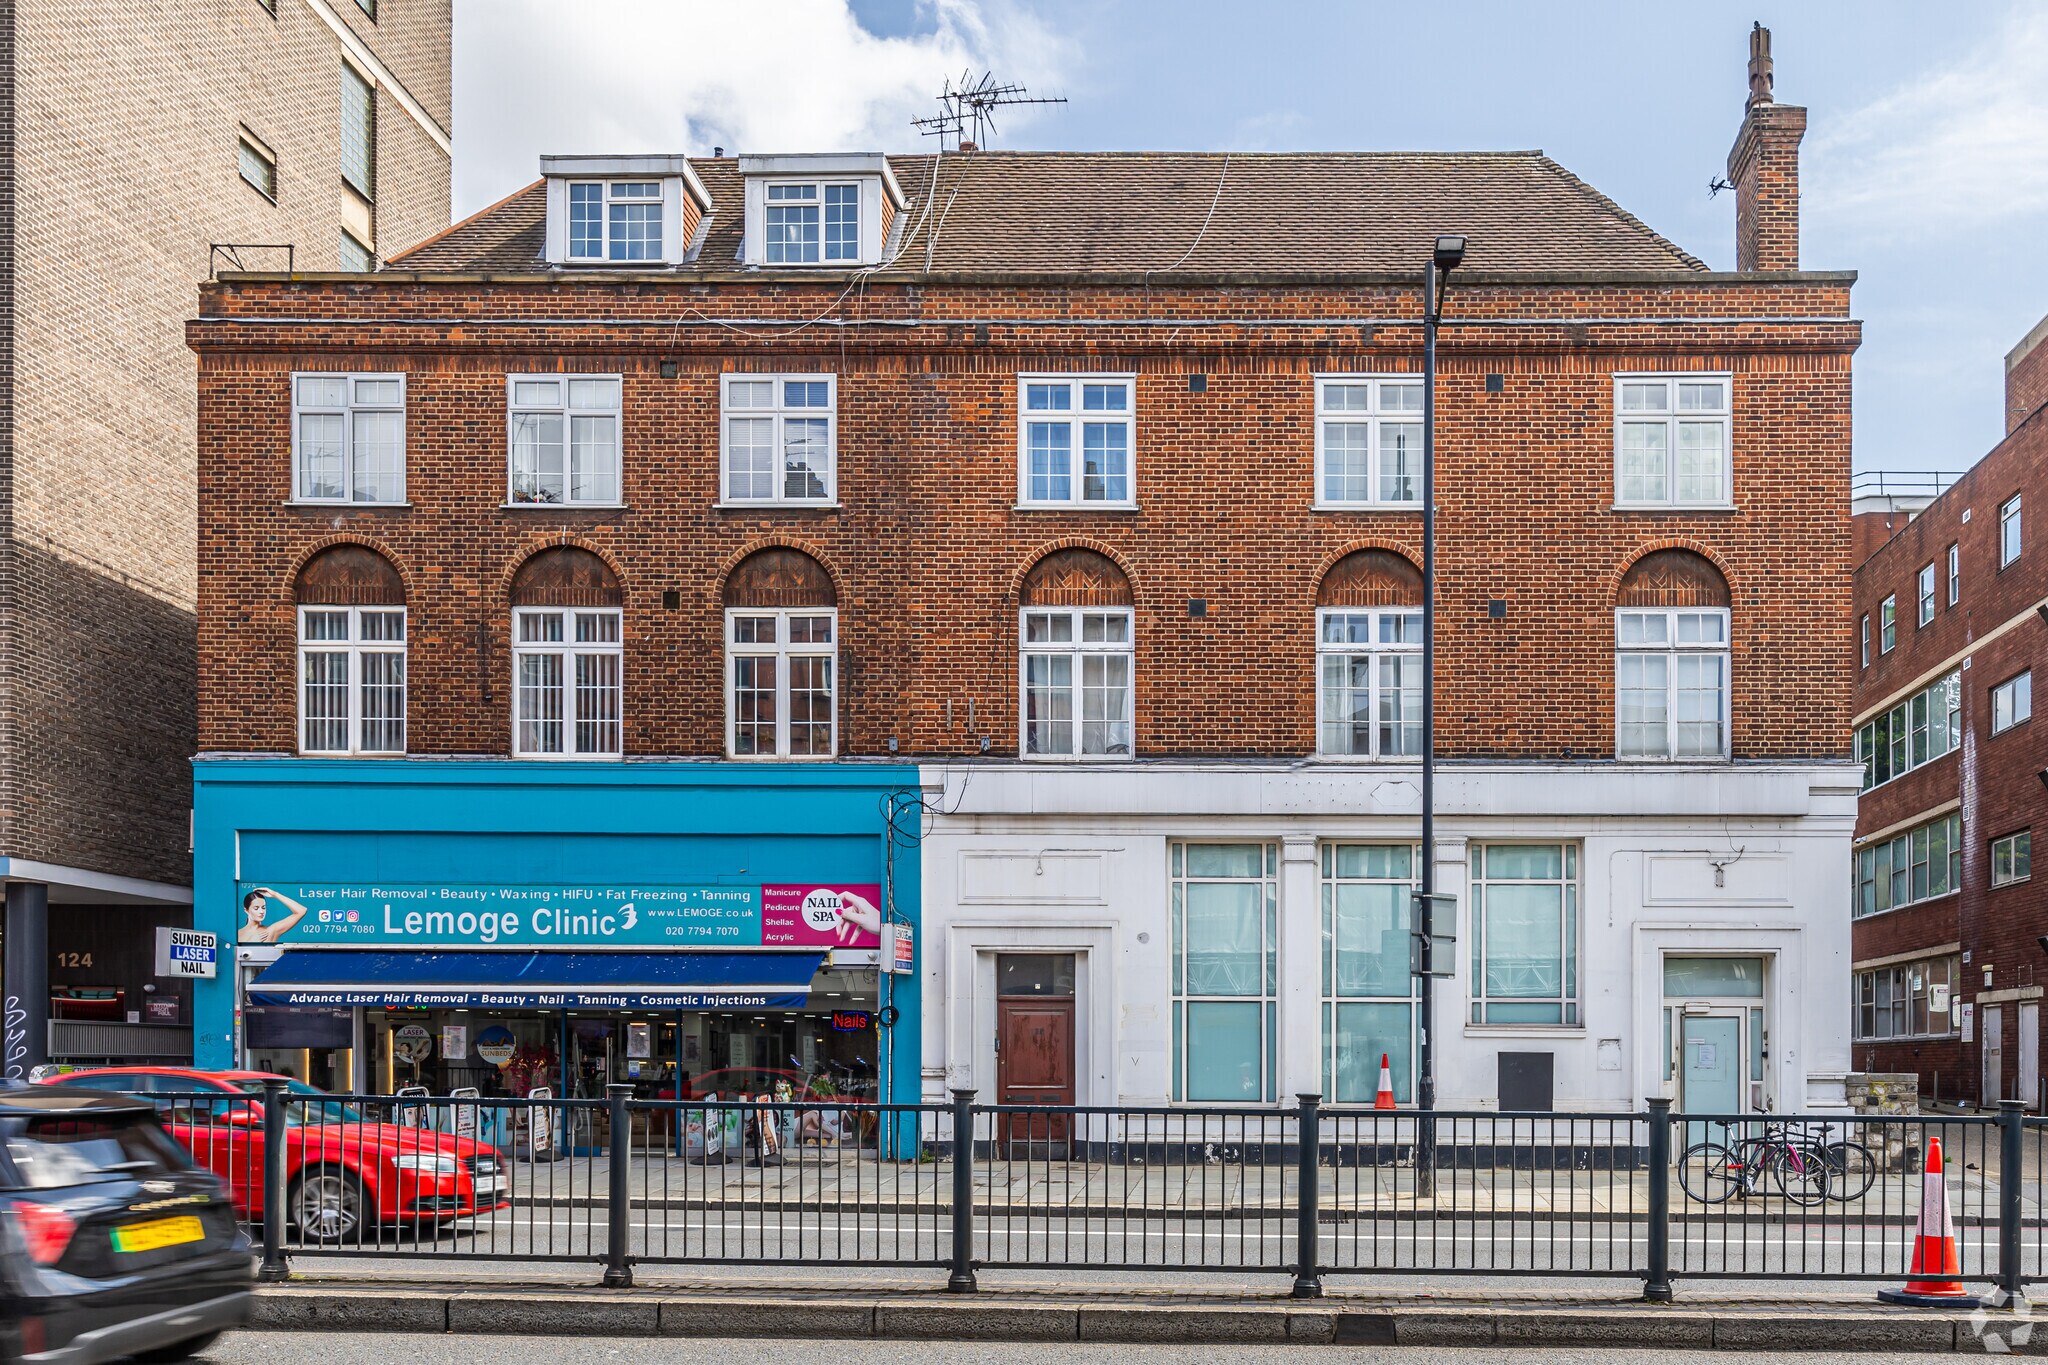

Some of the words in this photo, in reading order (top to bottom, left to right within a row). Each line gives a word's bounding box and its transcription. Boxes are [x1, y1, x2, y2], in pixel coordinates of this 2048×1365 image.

[299, 888, 337, 899] Laser
[341, 888, 367, 899] Hair
[371, 888, 428, 899] Removal
[440, 889, 487, 902] Beauty
[499, 889, 550, 902] Waxing
[562, 889, 593, 900] HIFU
[606, 889, 627, 900] Fat
[630, 889, 688, 903] Freezing
[700, 889, 751, 903] Tanning
[764, 888, 802, 897] Manicure
[764, 903, 800, 911] Pedicure
[807, 897, 841, 908] NAIL
[647, 908, 754, 918] www.LEMOGE.co.uk
[812, 911, 836, 922] SPA
[384, 904, 519, 943] Lemoge
[531, 907, 616, 936] Clinic
[765, 918, 794, 926] Shellac
[303, 925, 321, 933] 020
[324, 925, 348, 933] 7794
[352, 925, 375, 934] 7080
[665, 926, 684, 936] 020
[688, 926, 712, 936] 7794
[716, 926, 739, 936] 7070
[172, 932, 215, 948] SUNBED
[765, 933, 794, 941] Acrylic
[57, 952, 93, 967] 124
[176, 947, 210, 961] LASER
[181, 961, 205, 975] NAIL
[289, 993, 343, 1003] Advance
[346, 993, 380, 1003] Laser
[383, 993, 411, 1003] Hair
[414, 993, 469, 1004] Removal
[481, 994, 526, 1006] Beauty
[538, 995, 565, 1005] Nail
[577, 995, 628, 1006] Tanning
[640, 995, 699, 1006] Cosmetic
[702, 995, 767, 1007] Injections
[833, 1015, 867, 1029] Nails
